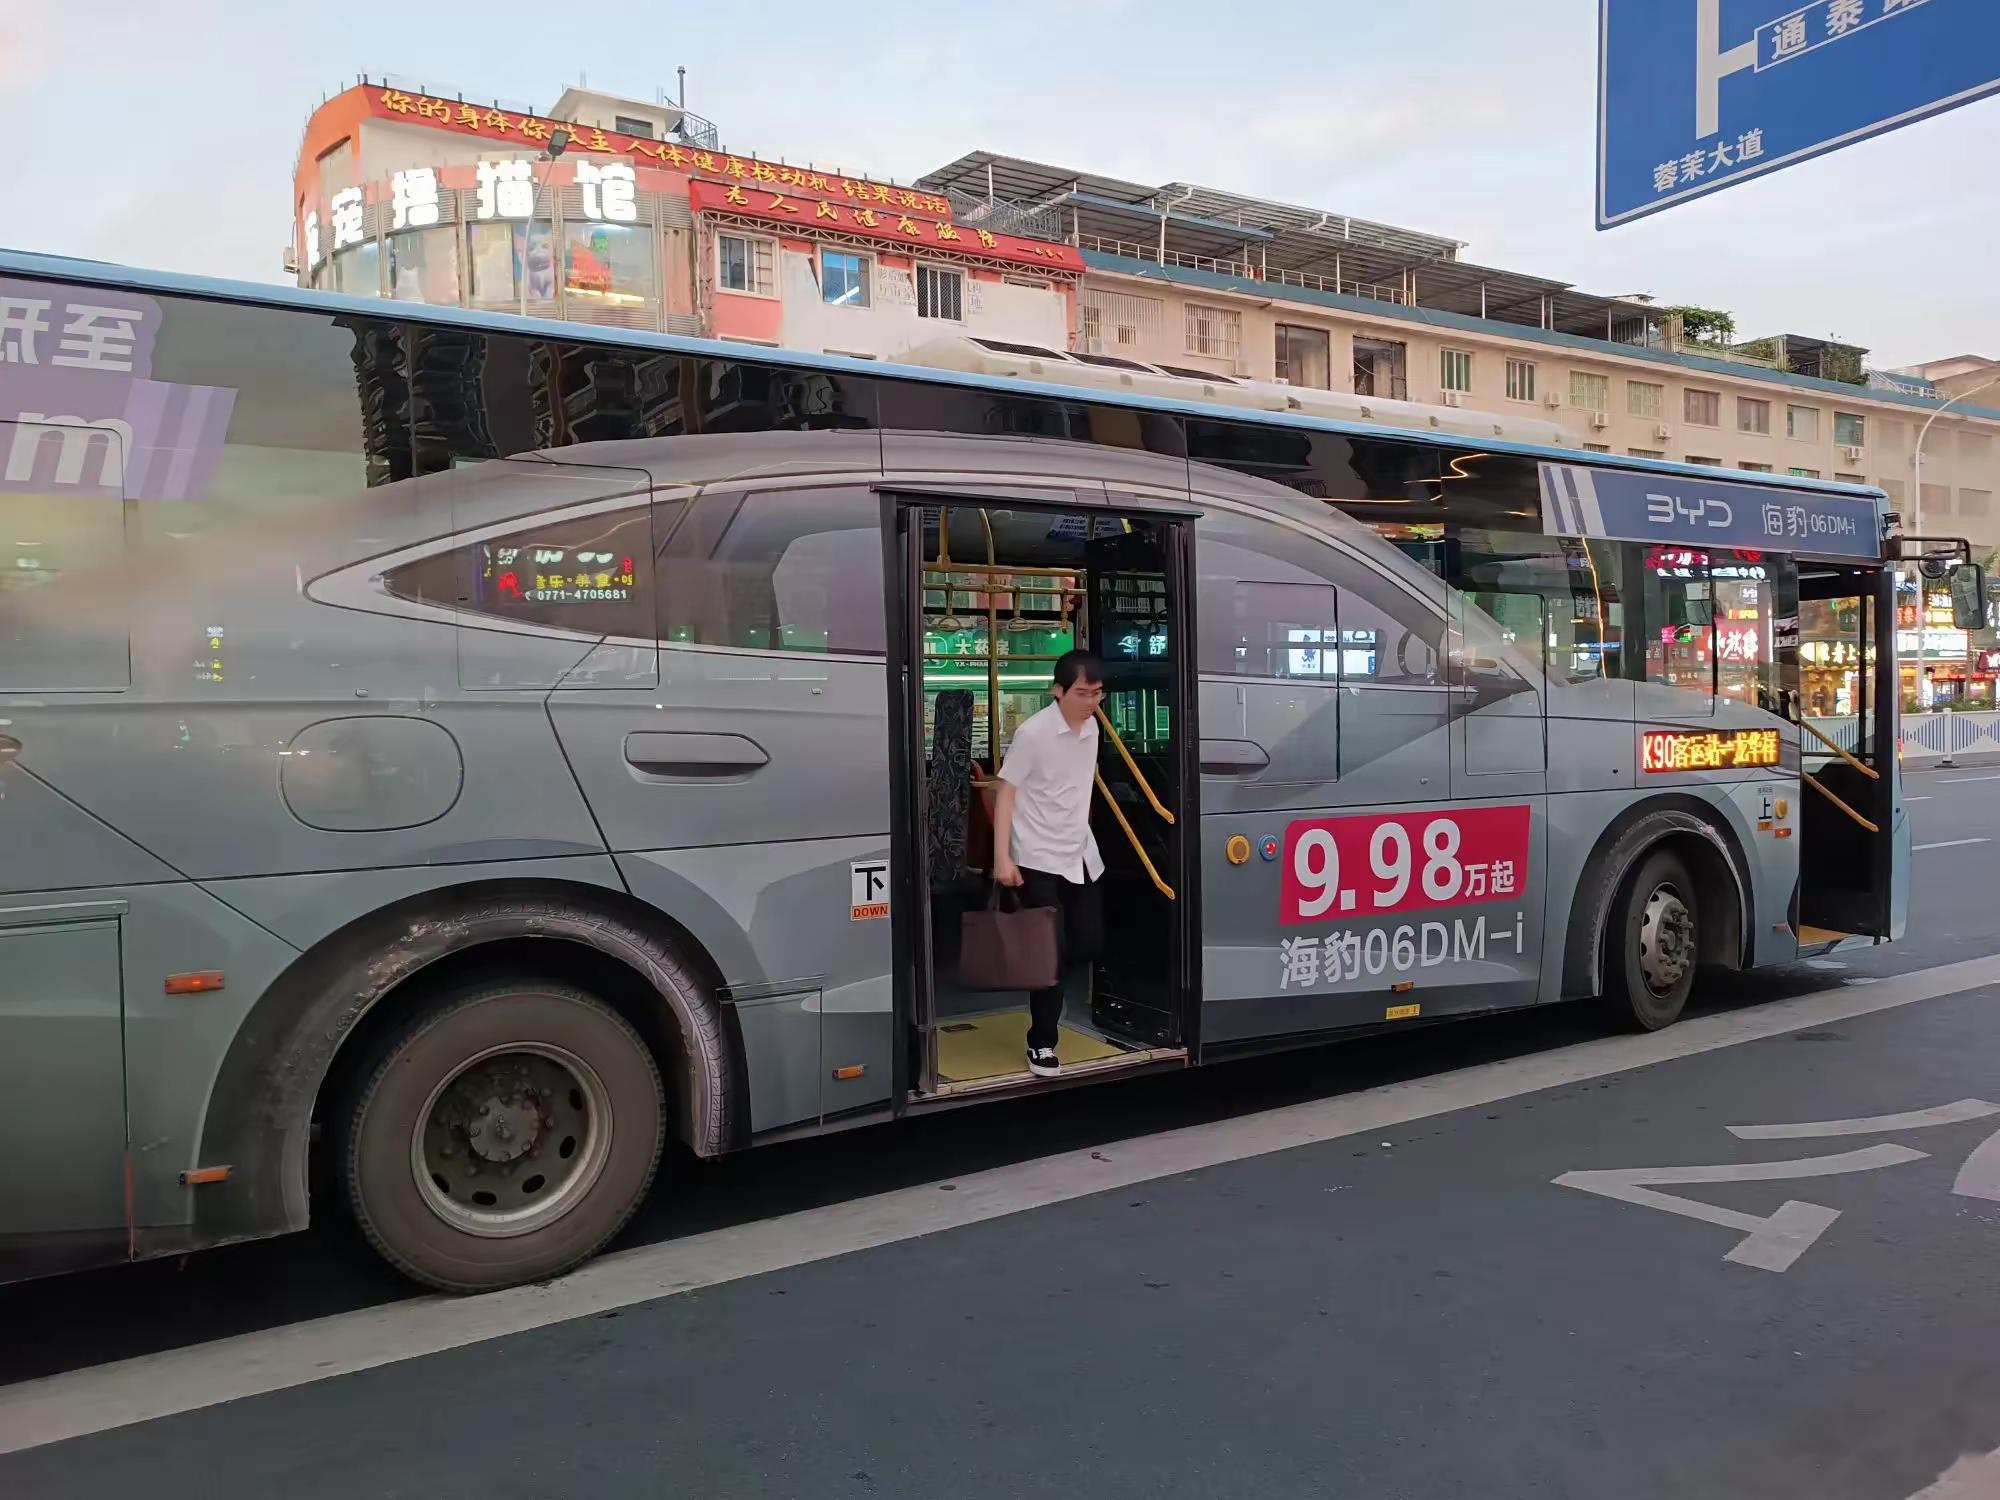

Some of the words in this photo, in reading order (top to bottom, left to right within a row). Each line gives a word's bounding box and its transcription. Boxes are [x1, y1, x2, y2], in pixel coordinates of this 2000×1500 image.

[1653, 128, 1764, 193] 蓉茉大道
[841, 178, 948, 215] 结果说话
[1646, 493, 1733, 527] BYD
[1758, 797, 1772, 820] 上
[854, 866, 887, 901] 下
[853, 905, 888, 918] DOWN
